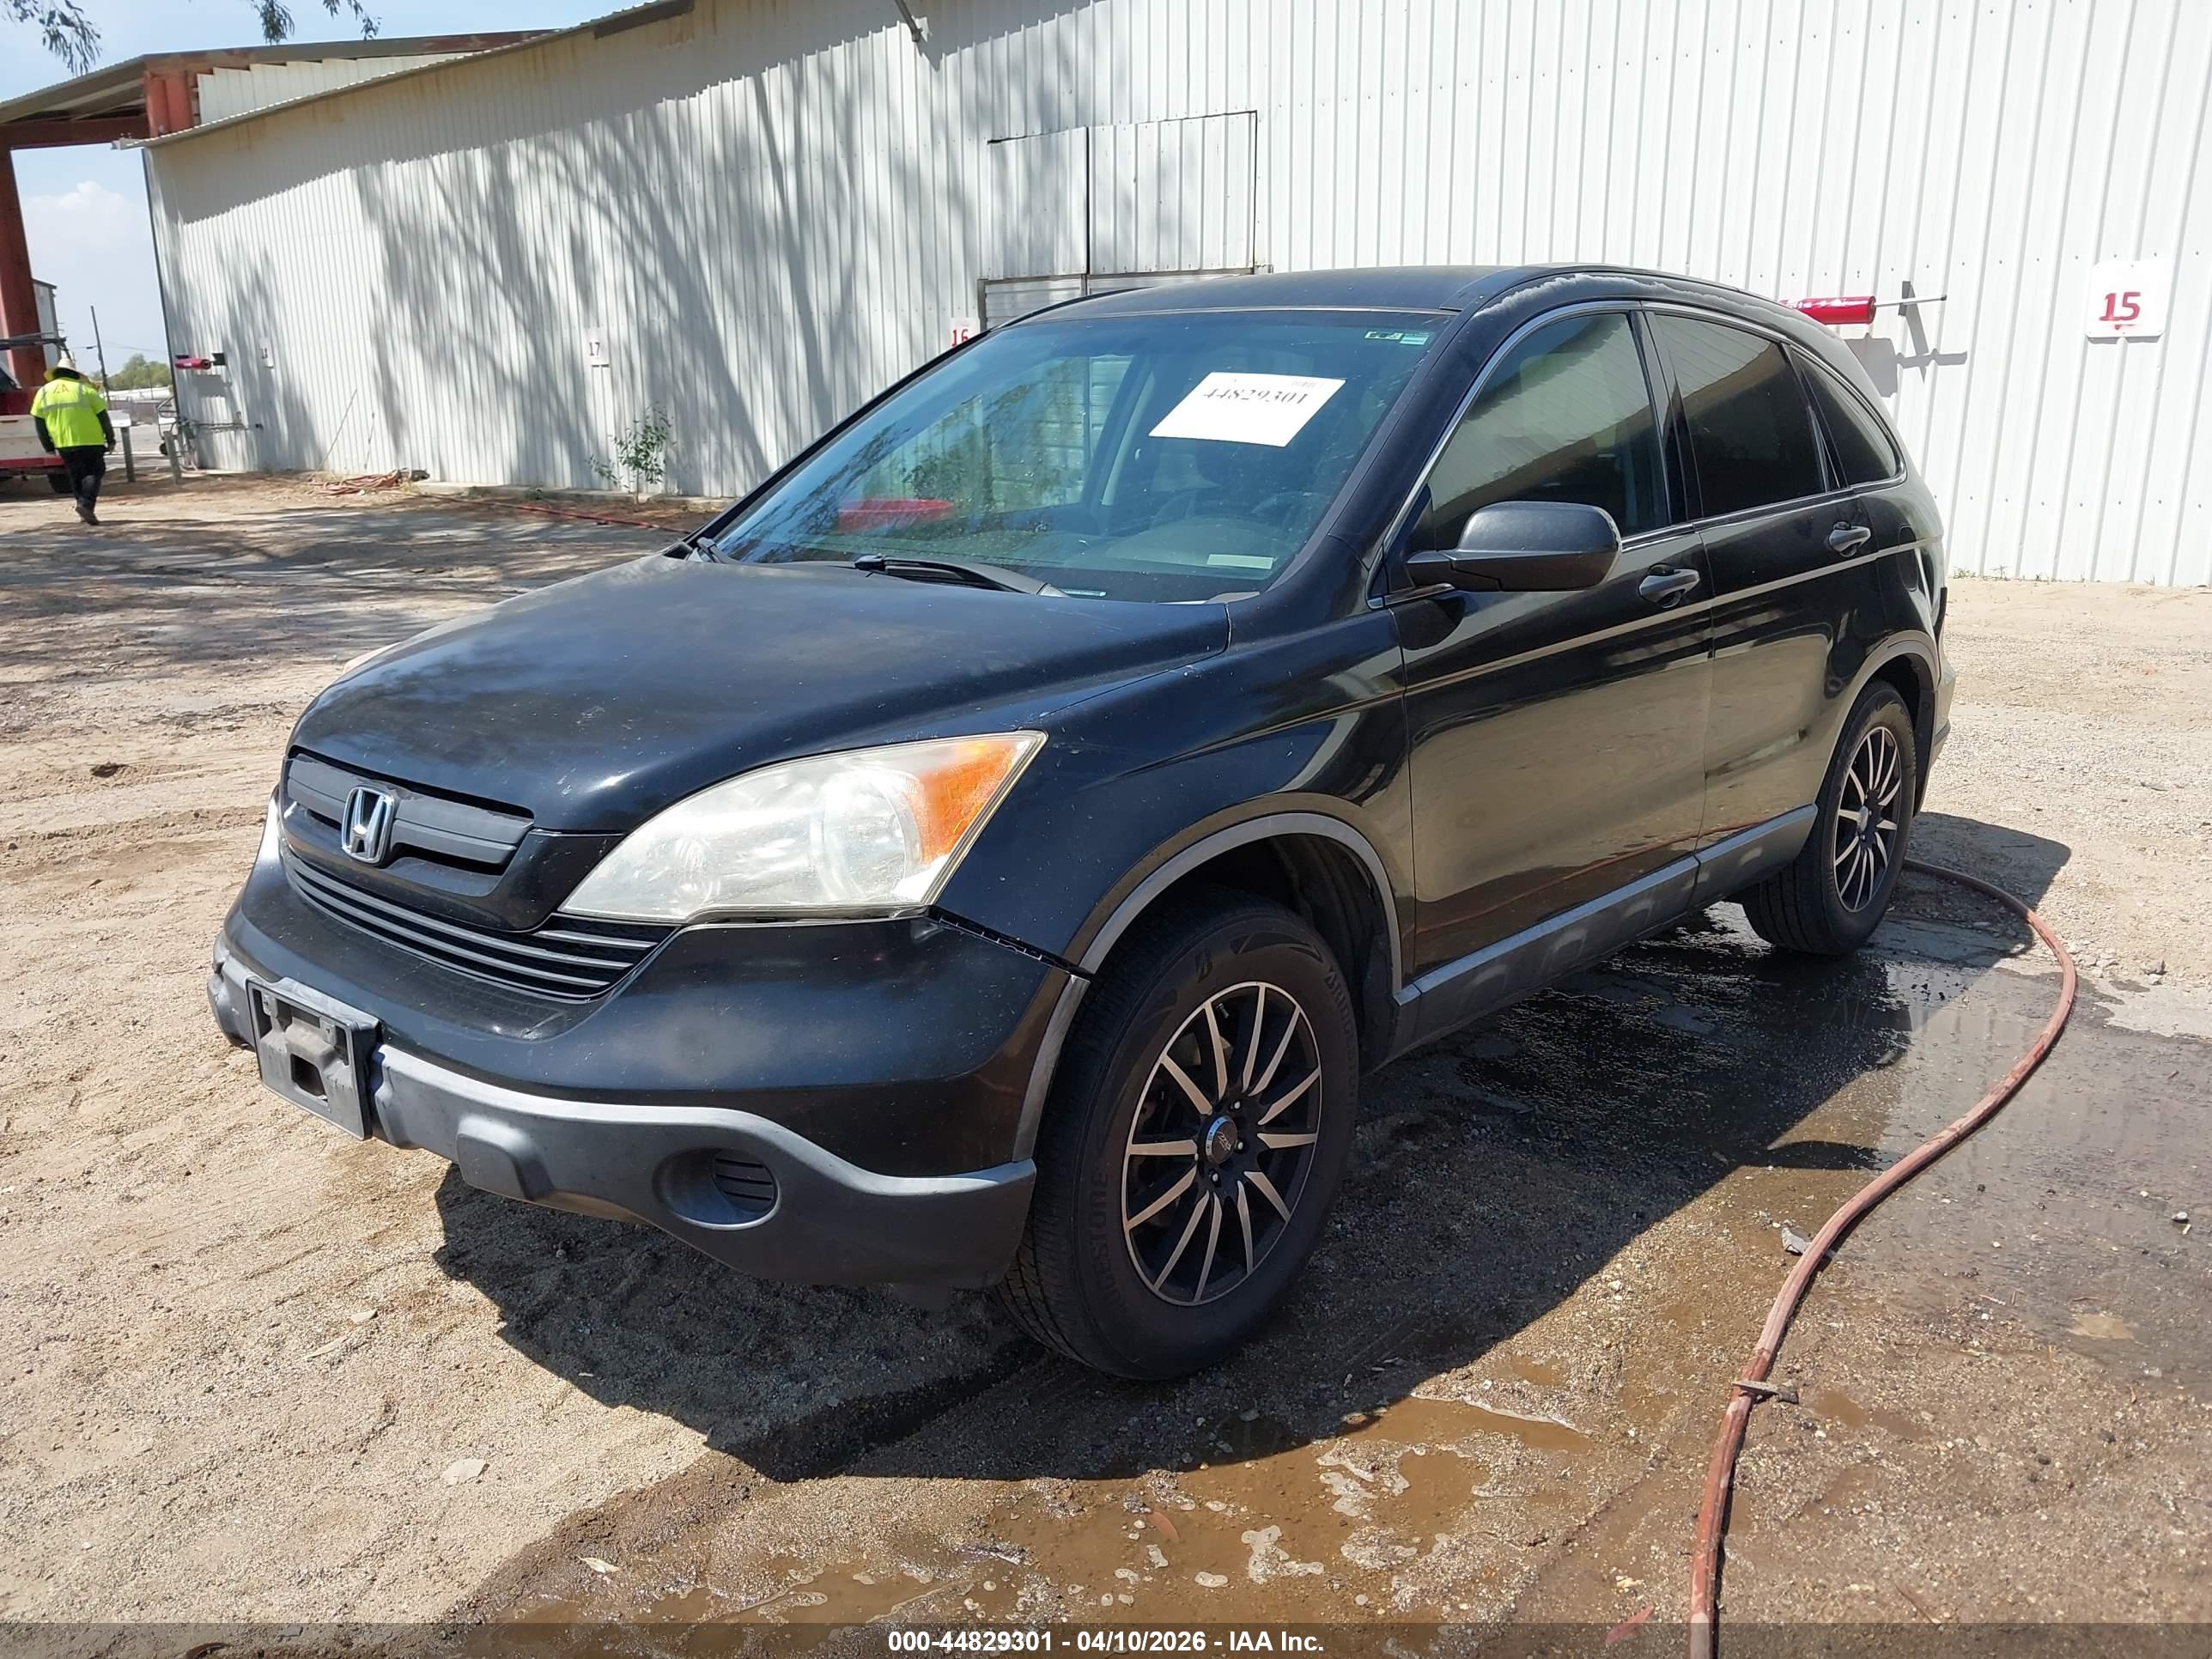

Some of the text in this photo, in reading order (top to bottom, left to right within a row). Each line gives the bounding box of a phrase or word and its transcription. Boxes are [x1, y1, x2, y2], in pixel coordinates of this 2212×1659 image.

[2099, 291, 2141, 322] 15
[951, 328, 969, 347] 16
[589, 342, 600, 356] 17
[1203, 388, 1309, 404] 44829301
